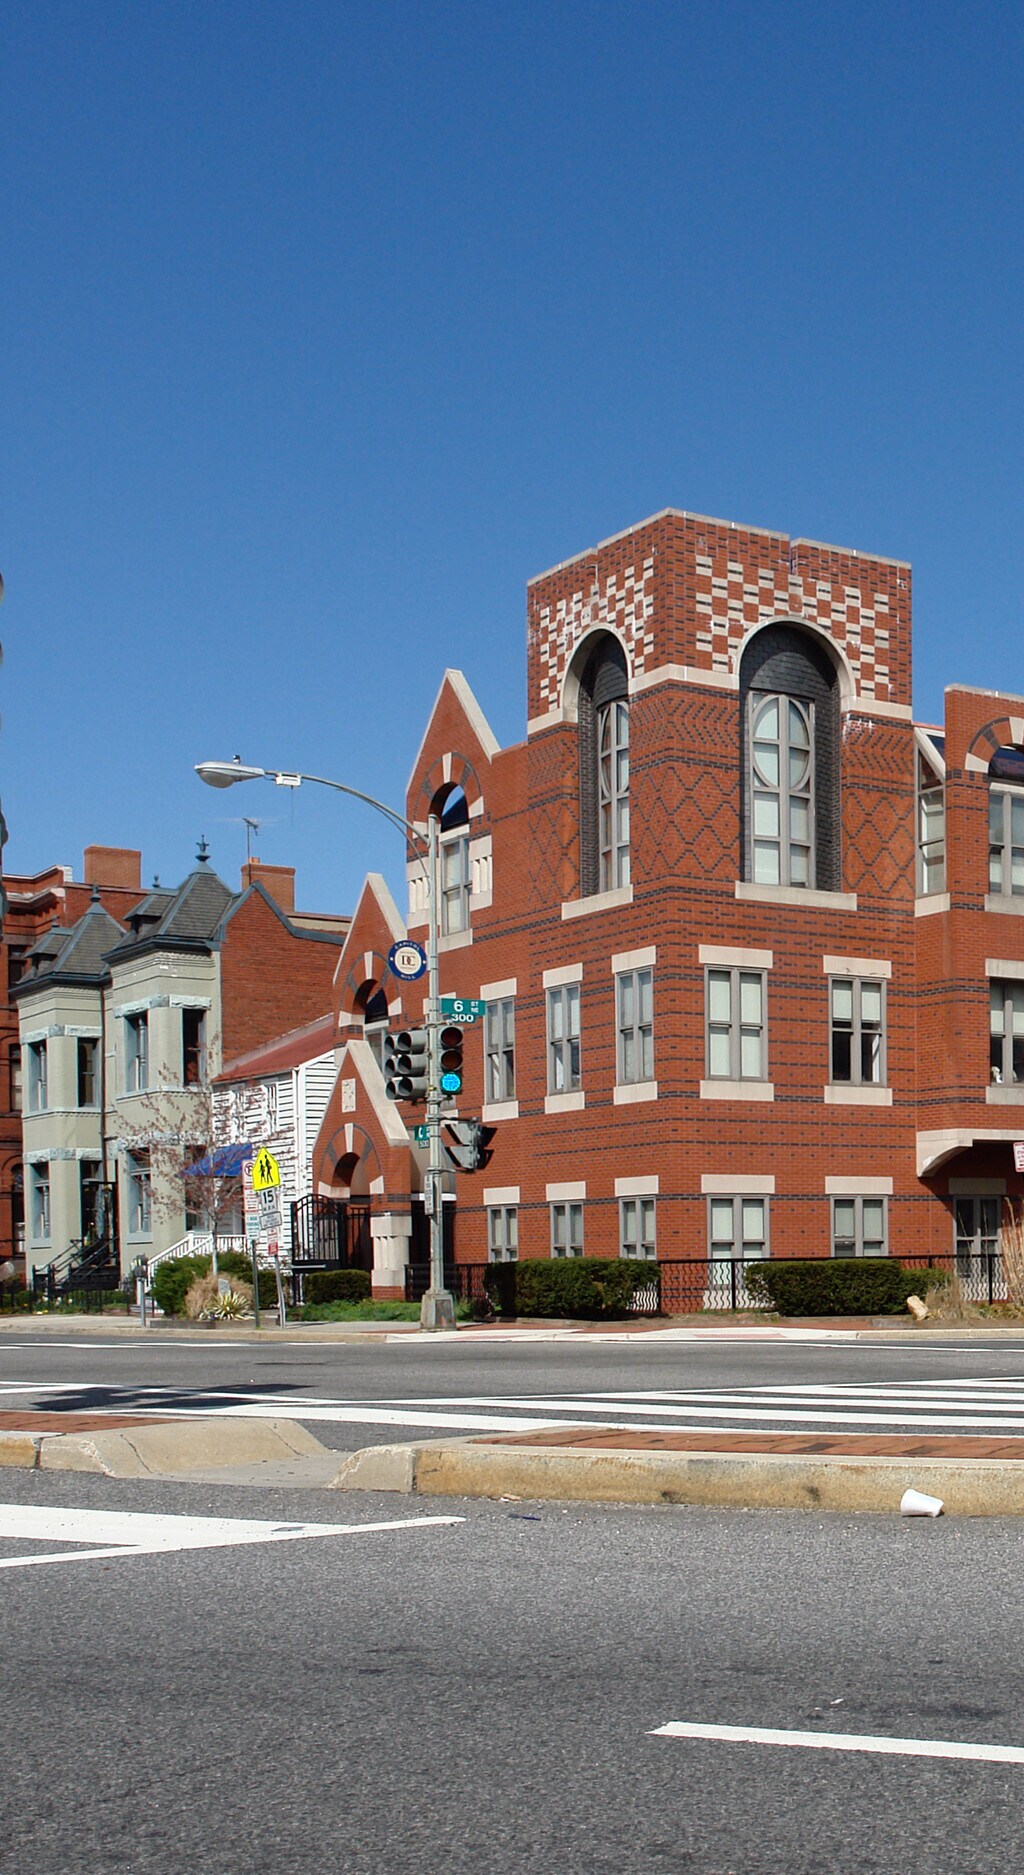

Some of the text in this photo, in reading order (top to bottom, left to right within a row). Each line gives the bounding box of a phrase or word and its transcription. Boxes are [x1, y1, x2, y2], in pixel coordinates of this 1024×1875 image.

[401, 955, 416, 967] DC
[453, 1000, 464, 1012] 6
[451, 1013, 475, 1023] 300
[263, 1190, 275, 1204] 15
